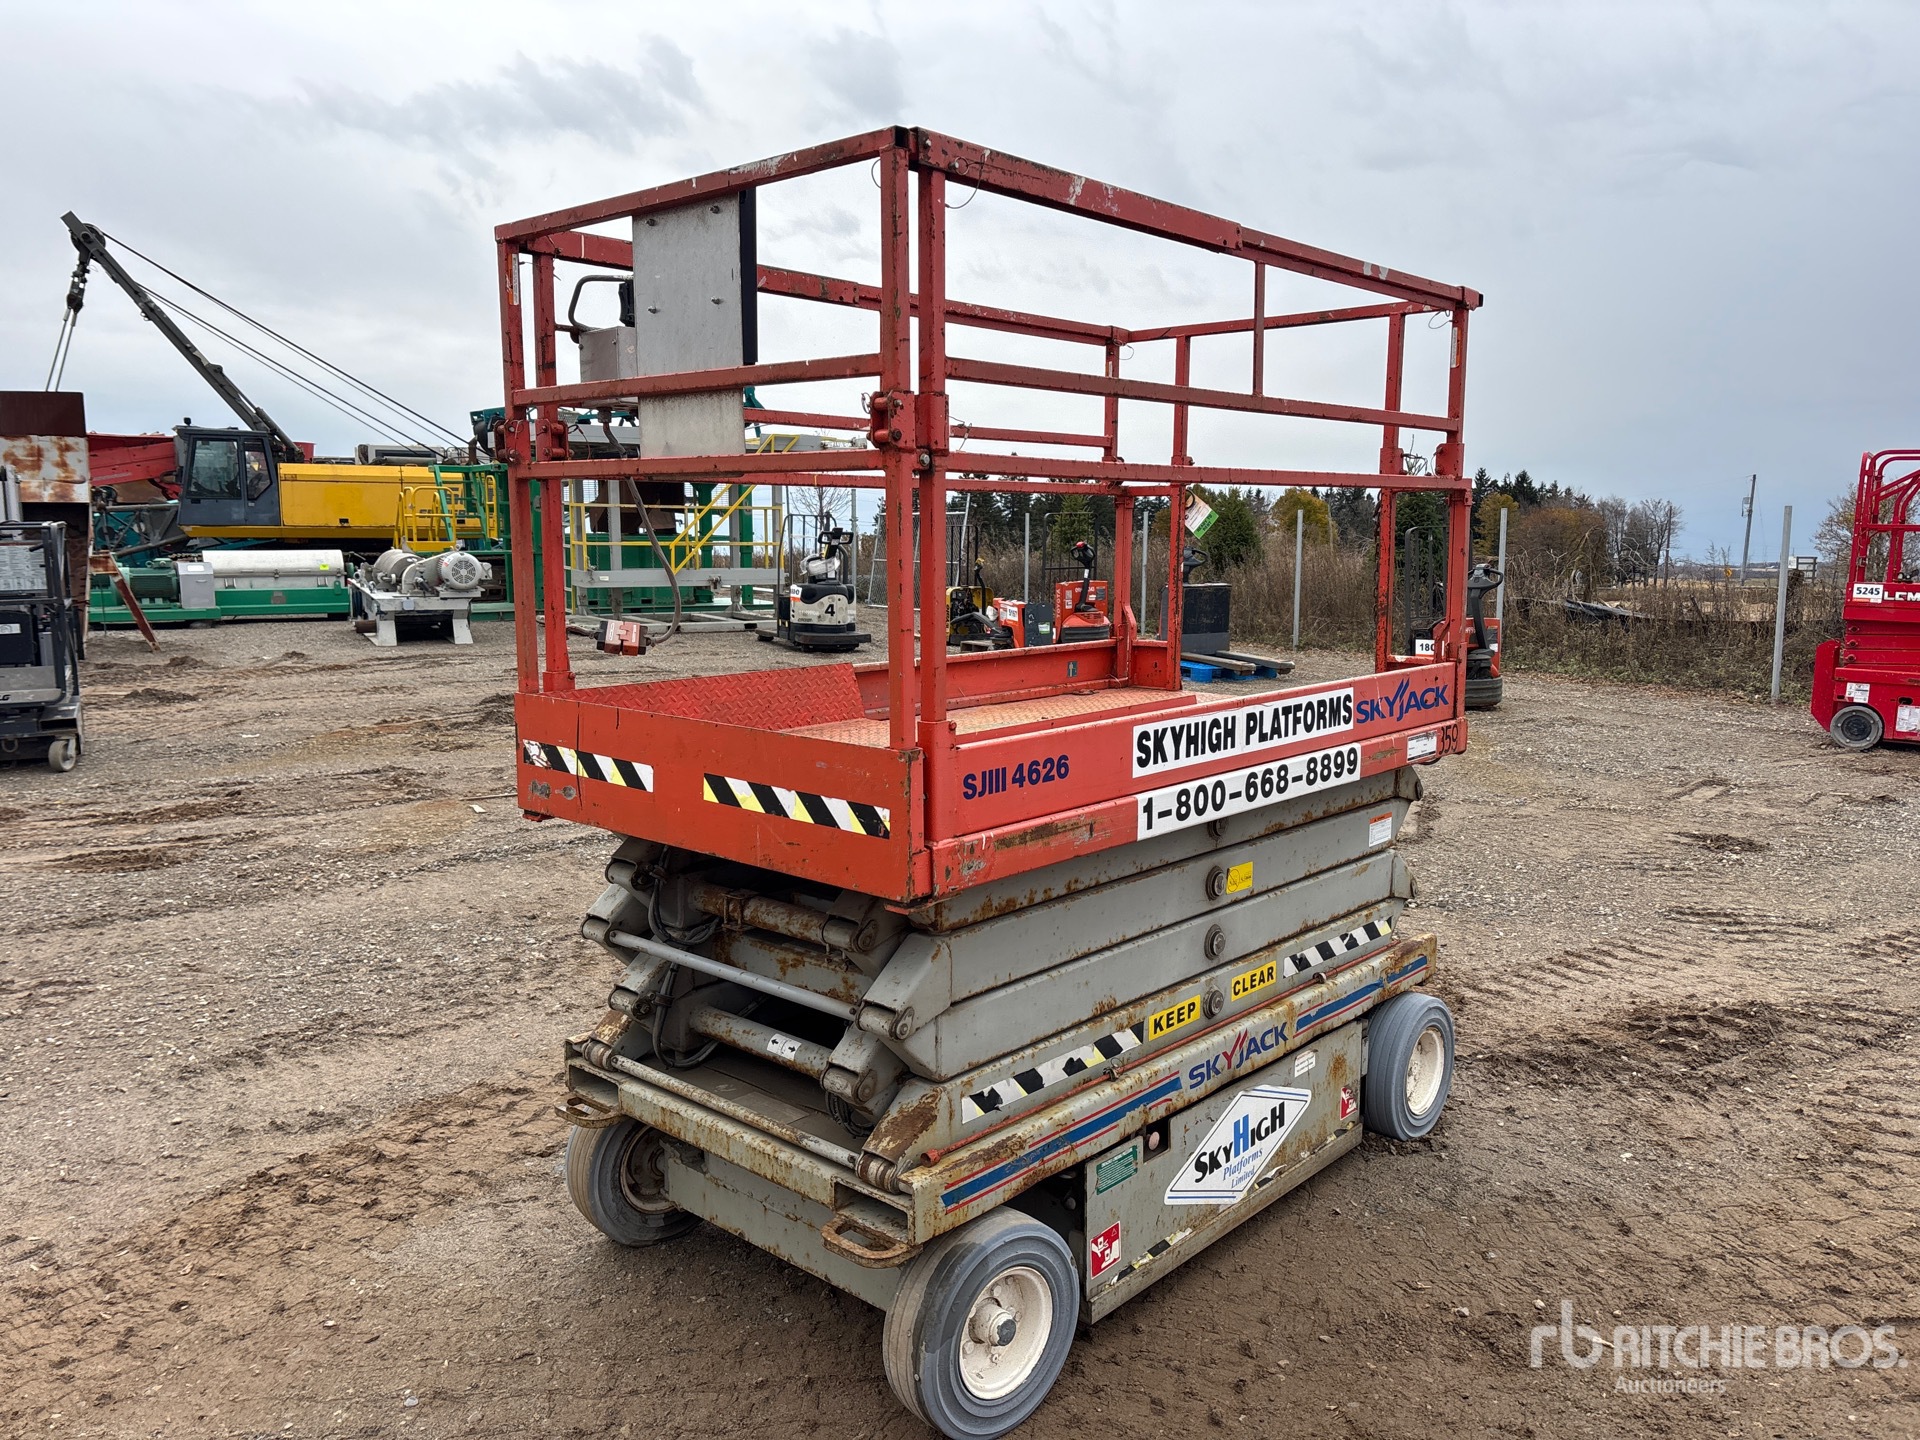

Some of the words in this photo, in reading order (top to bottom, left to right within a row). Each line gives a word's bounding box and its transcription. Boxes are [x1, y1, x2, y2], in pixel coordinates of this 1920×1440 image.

[1856, 587, 1881, 596] 5245
[825, 604, 835, 616] 4
[1356, 678, 1450, 724] SKYJACK
[1136, 715, 1236, 768] SKYHIGH
[1245, 693, 1353, 746] PLATFORMS
[1012, 755, 1069, 788] 4626
[1143, 747, 1358, 830] 1-800-668-8899
[1233, 966, 1275, 996] CLEAR
[1153, 1001, 1196, 1035] KEEP
[1188, 1022, 1289, 1090] SKYJACK
[1223, 1147, 1263, 1181] Platforms
[1231, 1166, 1255, 1189] Limited
